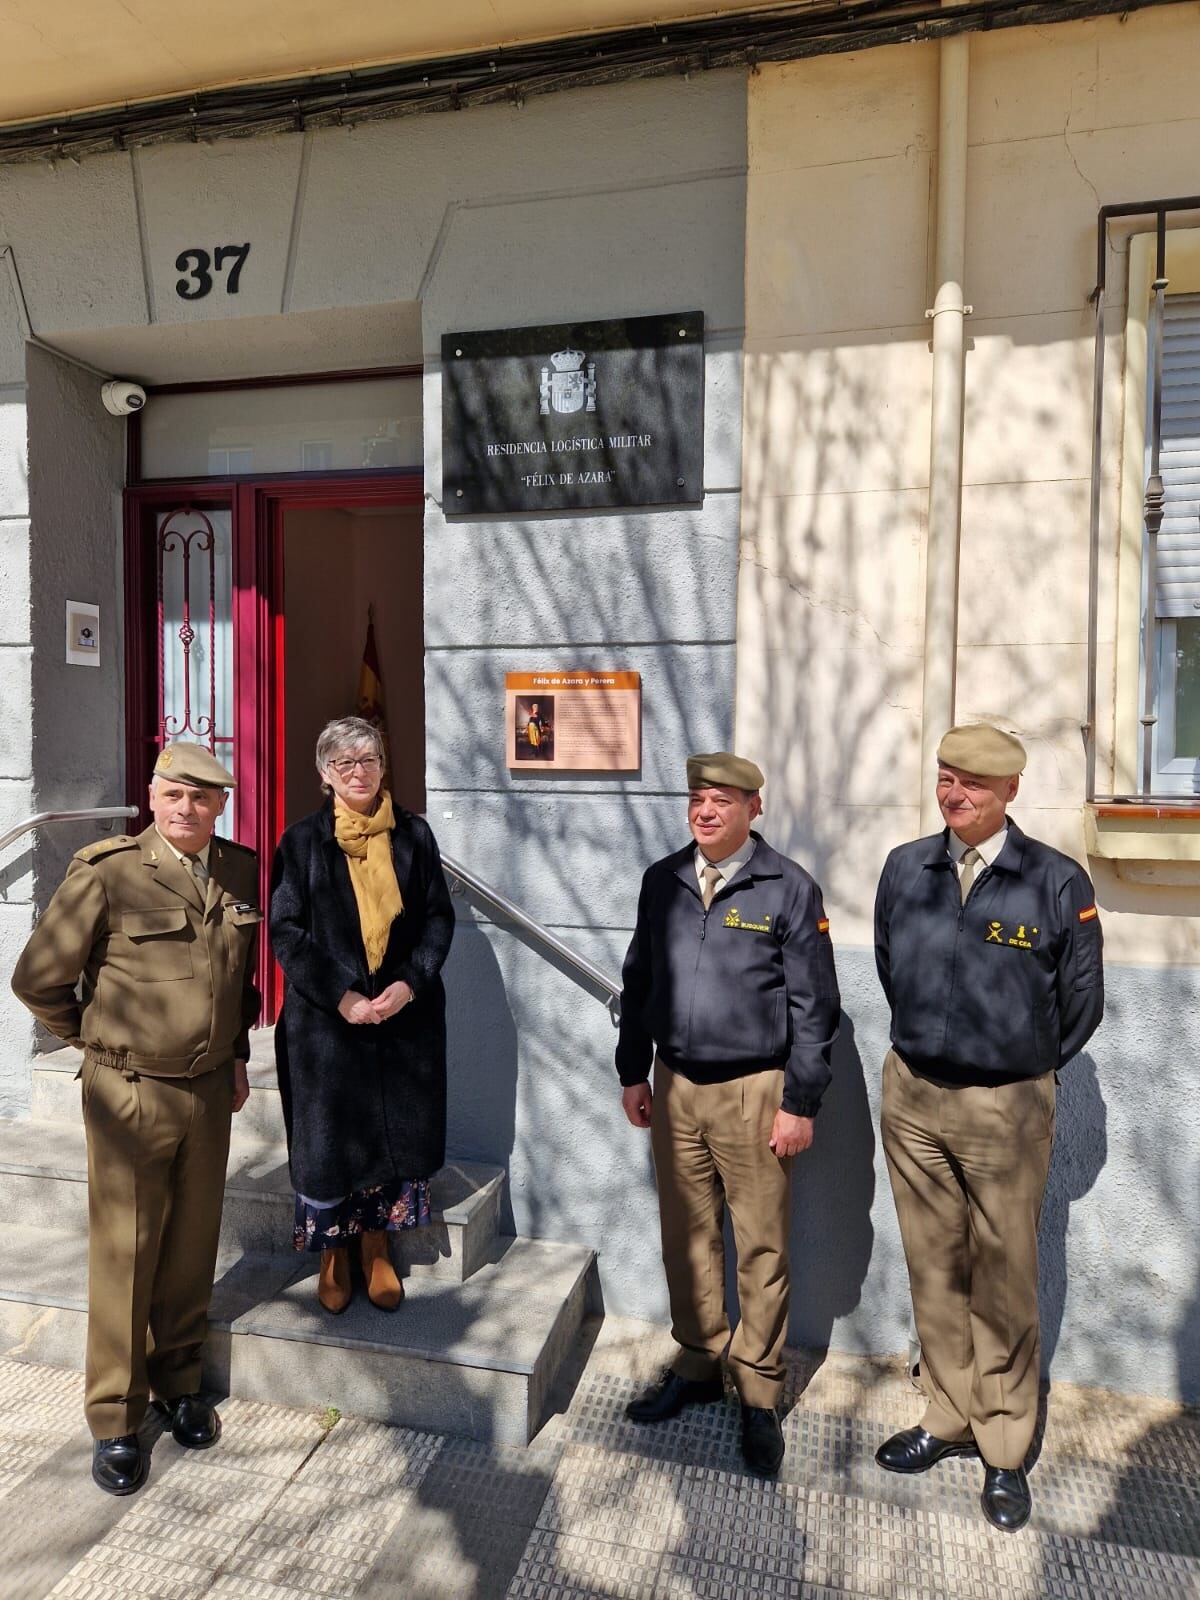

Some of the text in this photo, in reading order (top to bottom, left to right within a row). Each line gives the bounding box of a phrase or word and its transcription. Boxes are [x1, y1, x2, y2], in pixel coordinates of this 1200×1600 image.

[175, 242, 250, 300] 37
[487, 434, 651, 456] RESIDENCIA LOGÍSTICA MILITAR
[559, 472, 574, 485] DE
[533, 677, 615, 687] Félix de Azara y Perera
